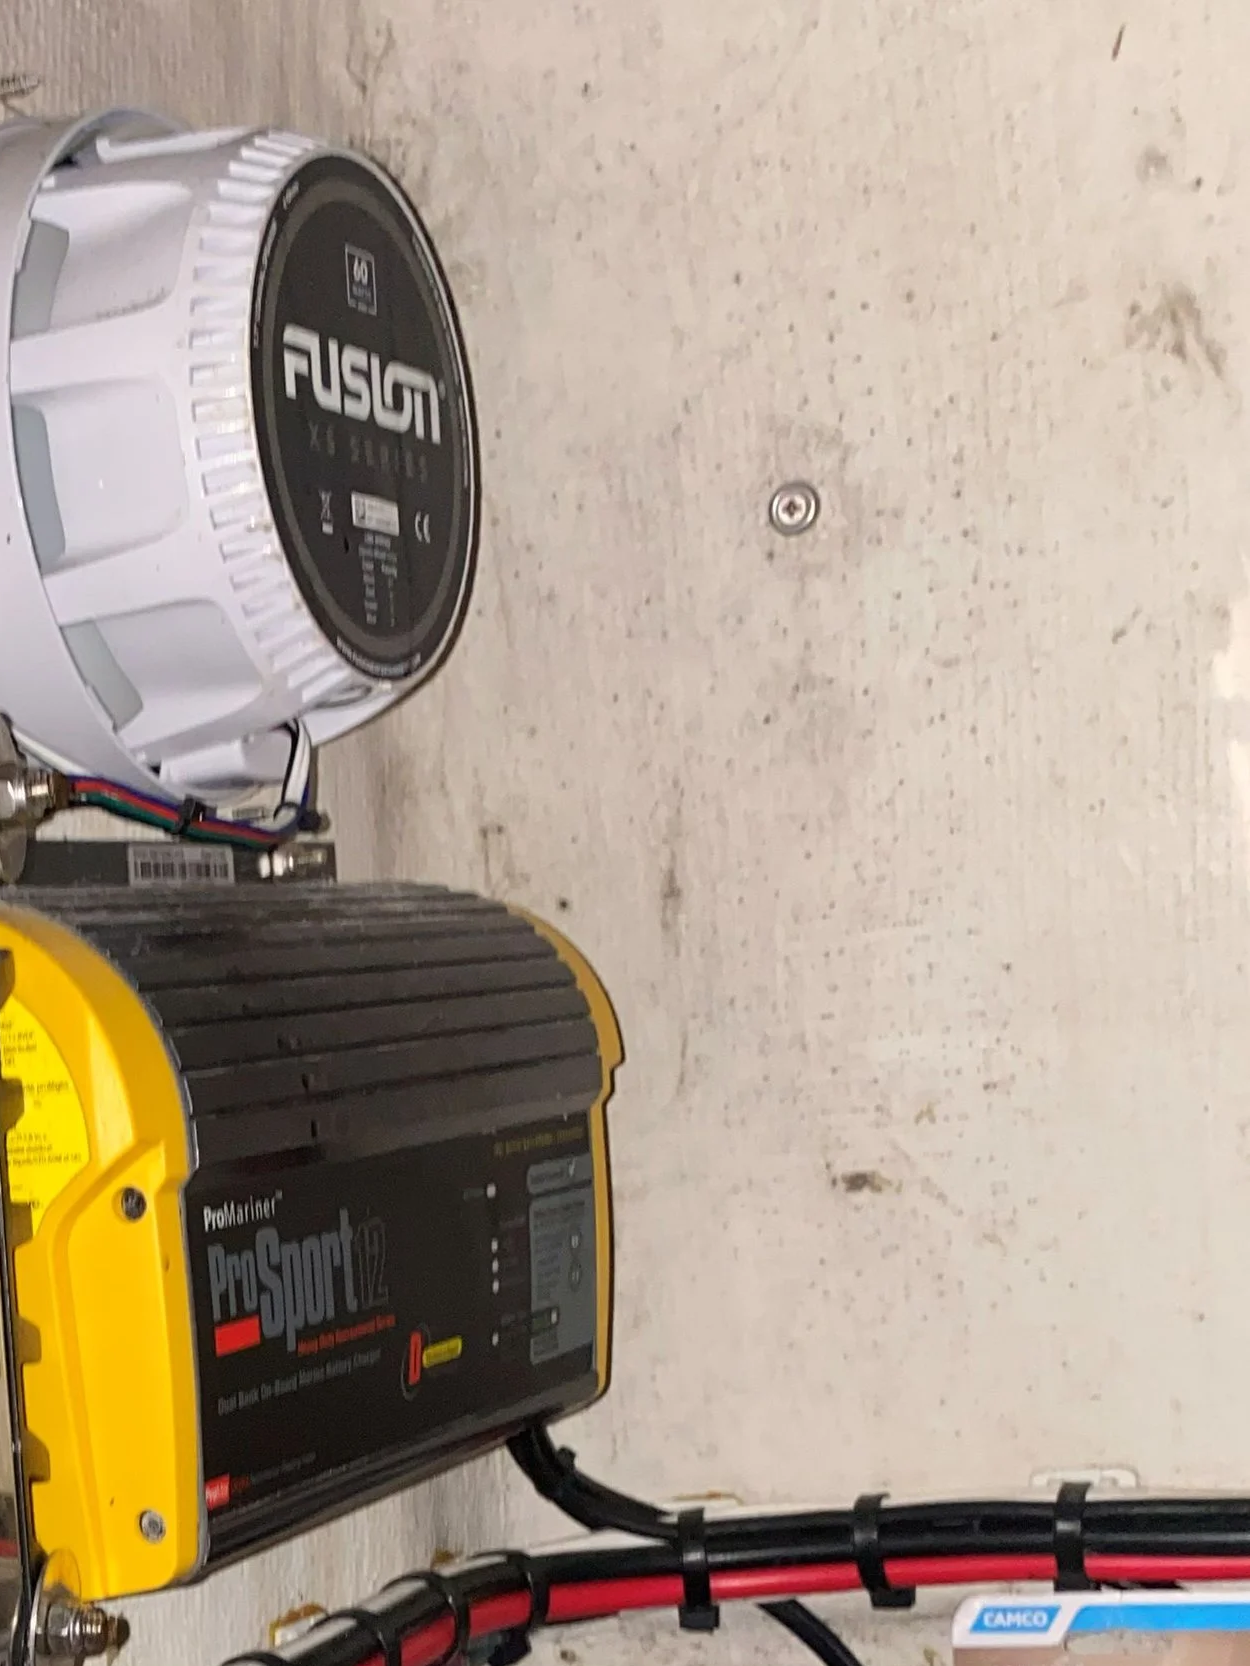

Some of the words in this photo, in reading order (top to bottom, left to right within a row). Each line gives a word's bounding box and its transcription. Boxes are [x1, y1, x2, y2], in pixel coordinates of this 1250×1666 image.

[282, 322, 441, 445] FUSION
[203, 1196, 278, 1232] ProMariner
[207, 1207, 357, 1352] ProSport
[983, 1610, 1048, 1628] CAMCO
